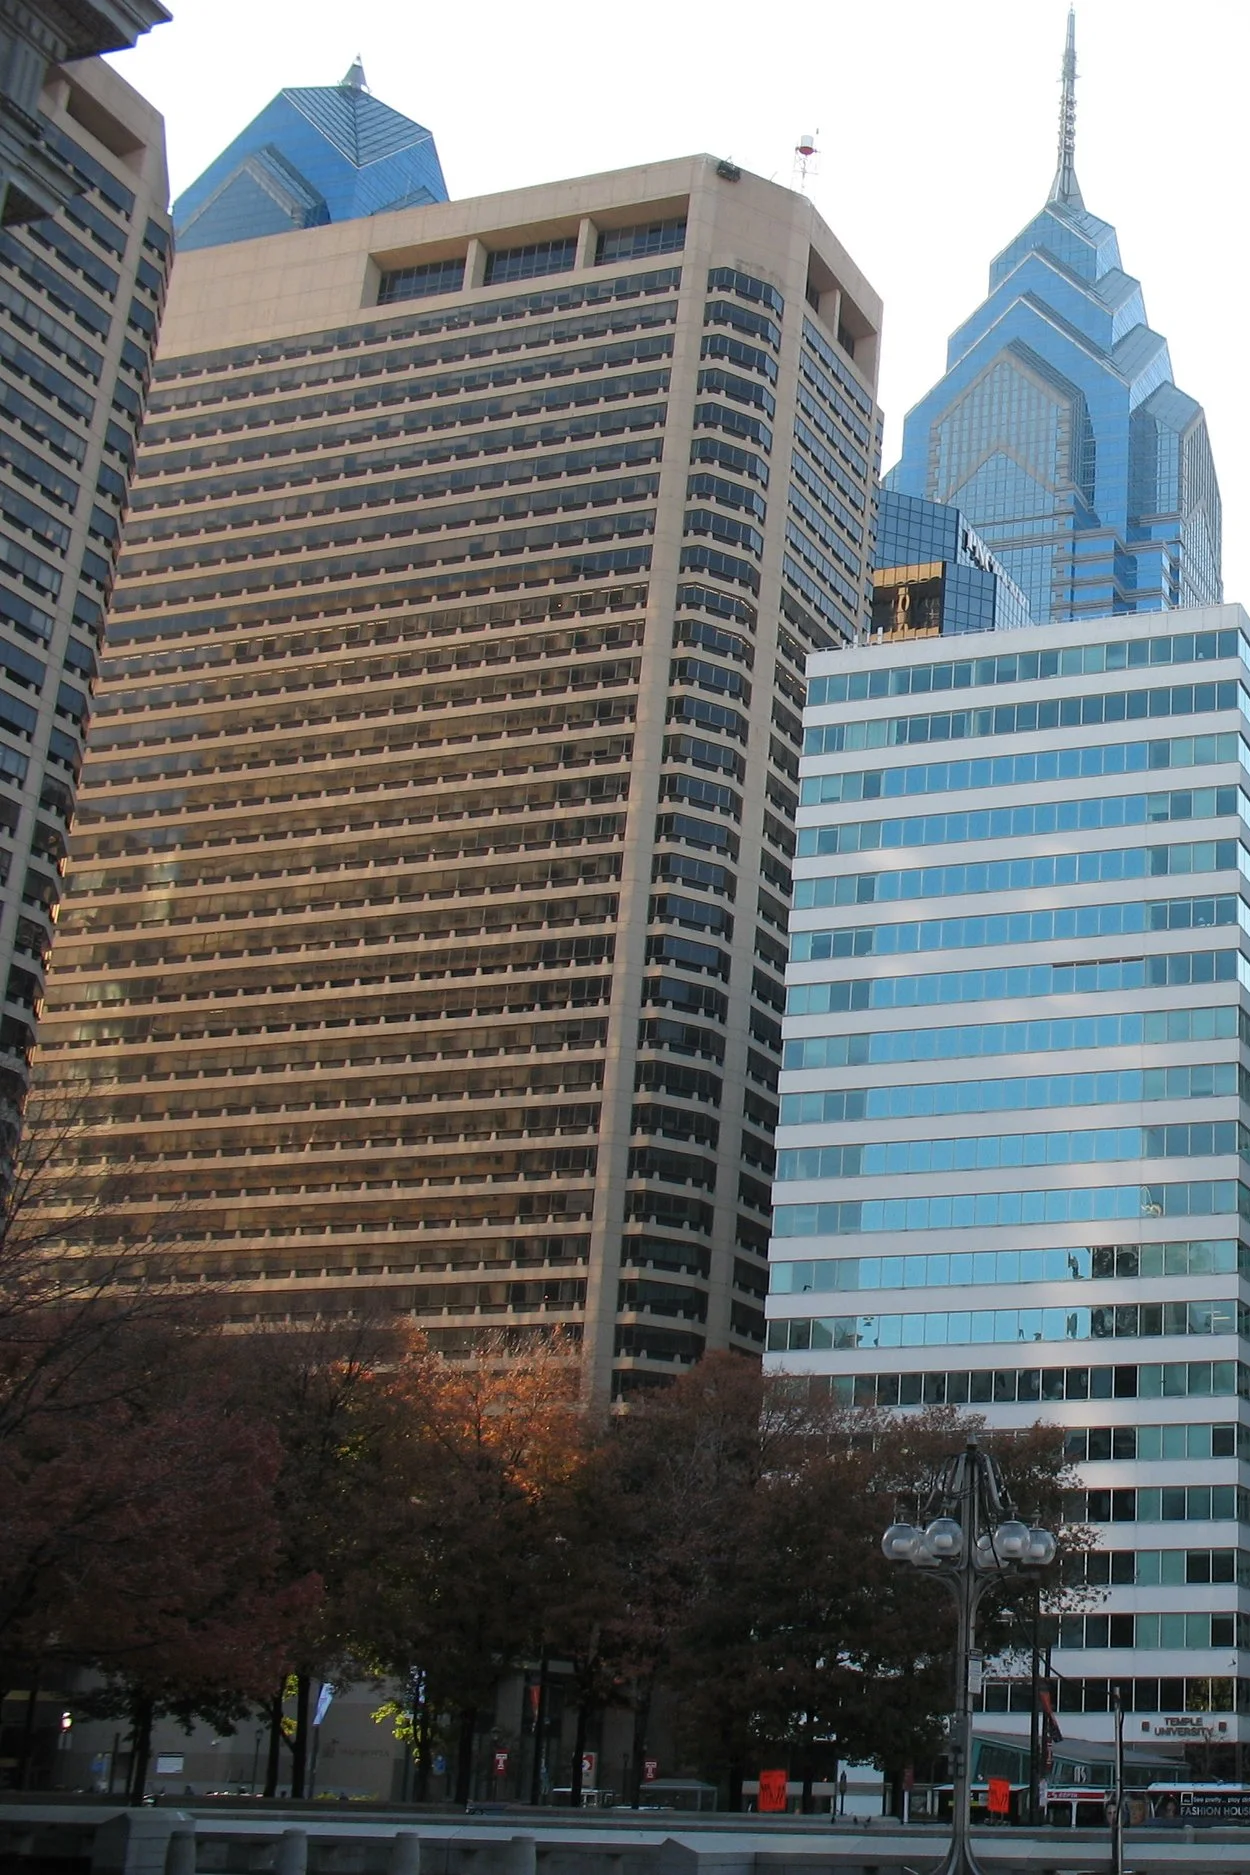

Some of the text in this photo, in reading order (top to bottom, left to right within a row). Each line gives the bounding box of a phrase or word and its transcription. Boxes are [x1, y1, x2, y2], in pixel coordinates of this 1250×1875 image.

[1164, 1717, 1204, 1727] TEMPLE
[1154, 1727, 1214, 1737] UNIVERSITY
[1180, 1806, 1221, 1816] FASHION
